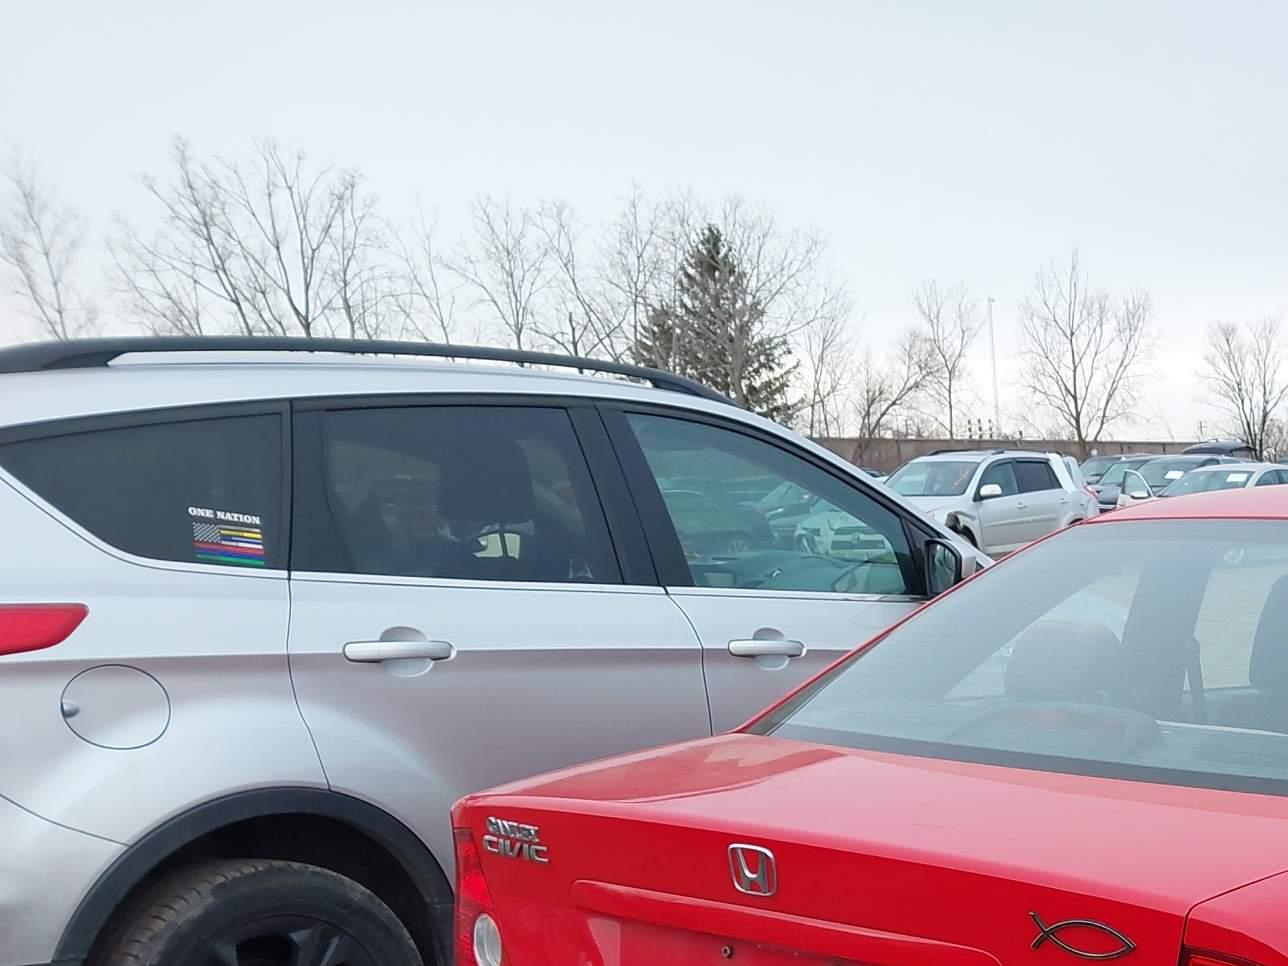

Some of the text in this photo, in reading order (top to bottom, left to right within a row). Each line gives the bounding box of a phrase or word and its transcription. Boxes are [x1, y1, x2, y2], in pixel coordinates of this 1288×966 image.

[188, 507, 260, 525] ONE NATION
[483, 834, 548, 863] CIVIC
